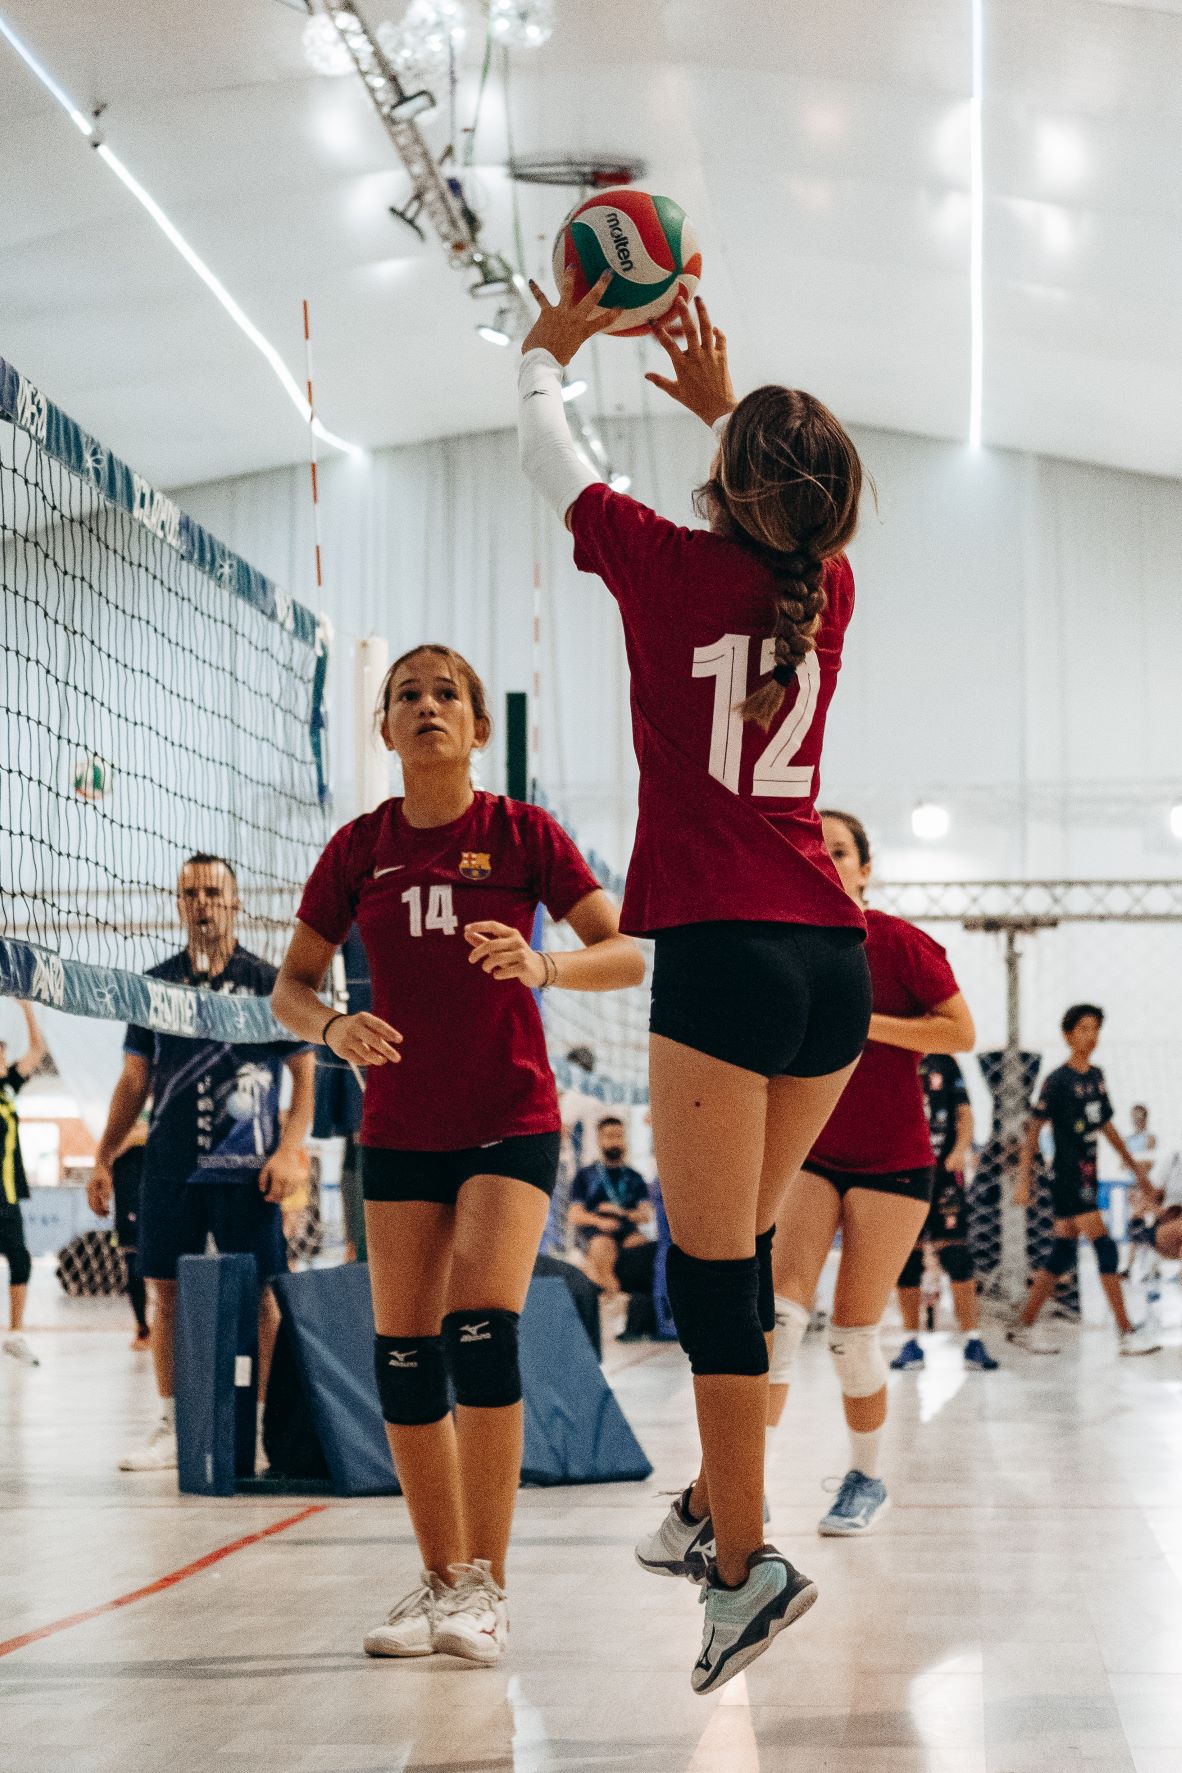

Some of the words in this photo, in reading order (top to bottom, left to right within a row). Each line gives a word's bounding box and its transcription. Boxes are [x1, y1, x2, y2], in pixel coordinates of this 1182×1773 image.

[606, 213, 633, 271] molten
[692, 633, 820, 797] 12
[401, 884, 458, 937] 14
